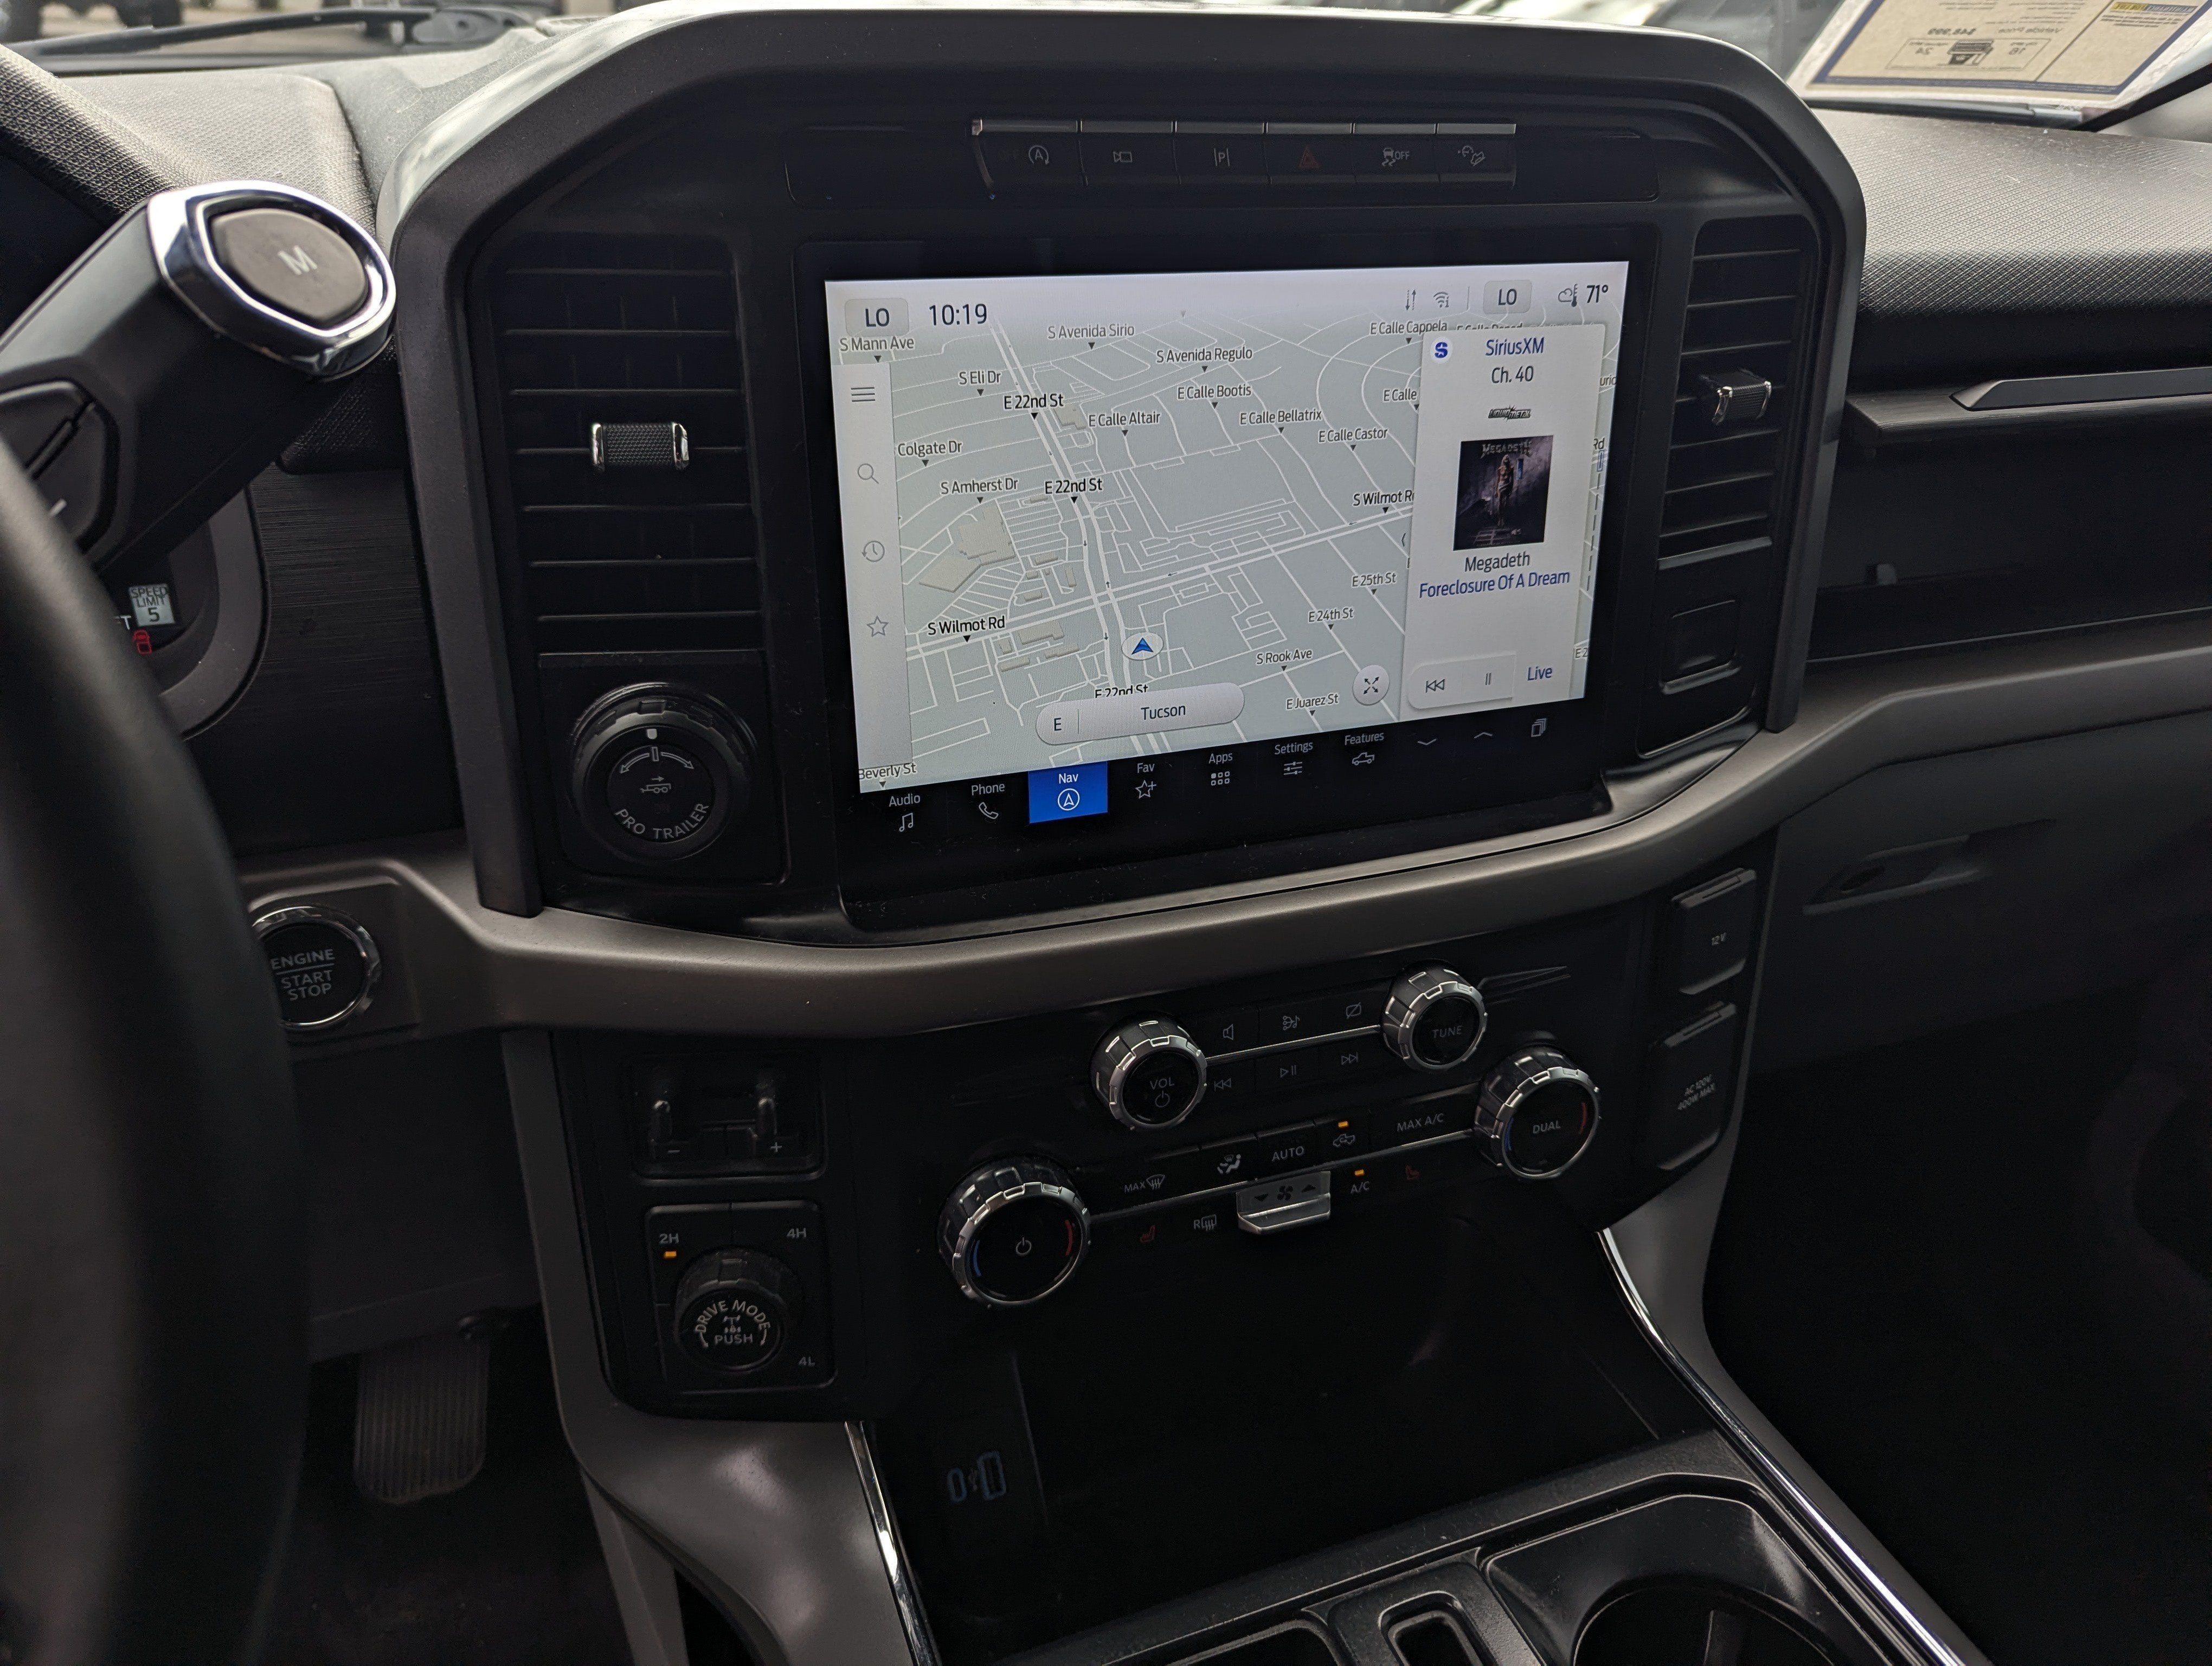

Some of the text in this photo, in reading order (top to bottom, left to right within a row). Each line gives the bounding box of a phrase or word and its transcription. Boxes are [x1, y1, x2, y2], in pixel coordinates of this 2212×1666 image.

[1394, 150, 1410, 161] OFF
[277, 244, 318, 276] M
[1498, 289, 1517, 306] LO
[865, 307, 890, 327] LO
[929, 303, 987, 326] 10:19
[1049, 323, 1134, 339] S Avenida Sirio
[1371, 323, 1377, 334] E
[1379, 322, 1404, 334] Calle
[840, 336, 914, 351] S Mann Ave
[1485, 337, 1545, 356] SiriusXM
[1156, 347, 1252, 363] S Avenida Regulo
[959, 370, 1001, 385] S Eli Dr
[1491, 366, 1534, 384] Ch. 40
[1178, 385, 1251, 399] E Calle Bootis
[1384, 388, 1417, 401] E Calle
[1004, 393, 1064, 409] E 22nd St
[1089, 412, 1161, 427] E Calle Altair
[1240, 408, 1322, 425] E Calle Bellatrix
[1319, 427, 1388, 443] E Calle Castor
[898, 440, 962, 458] Colgate Dr
[941, 478, 1018, 495] S Amherst Dr
[1045, 478, 1103, 494] E 22nd St
[1353, 494, 1360, 506] S
[1363, 491, 1402, 505] Wilmot
[1464, 551, 1530, 573] Megadeth
[1352, 572, 1396, 587] E 25th St
[1419, 572, 1570, 598] Foreclosure Of A Dream
[131, 586, 168, 597] SPEED
[136, 596, 166, 607] LIMIT
[147, 607, 160, 622] 5
[1309, 607, 1353, 623] E 24th St
[928, 616, 1005, 636] S Wilmot Rd
[1257, 649, 1312, 664] S Rook Ave
[1527, 667, 1553, 681] Live
[1287, 694, 1339, 709] E Juarez St
[1053, 703, 1186, 732] E Tucson
[1345, 731, 1384, 746] Features
[1274, 740, 1314, 756] Settings
[1208, 751, 1233, 765] Apps
[859, 762, 916, 779] Beverly St
[1137, 761, 1155, 774] Fav
[1058, 772, 1079, 785] Nav
[971, 781, 1005, 797] Phone
[889, 793, 921, 808] Audio
[615, 803, 709, 839] PRO TRAILER
[271, 949, 336, 970] ENGINE
[281, 970, 333, 989] START
[288, 983, 332, 1002] STOP
[1431, 1024, 1463, 1040] TUNE
[1149, 1078, 1175, 1091] VOL
[1397, 1113, 1445, 1132] MAX A/C
[1532, 1120, 1561, 1135] DUAL
[1271, 1145, 1306, 1163] AUTO
[1123, 1180, 1146, 1194] MAX
[1350, 1180, 1371, 1194] A/C
[1194, 1220, 1200, 1229] R
[659, 1233, 680, 1245] 2H
[787, 1228, 807, 1239] 4H
[695, 1299, 771, 1334] DRIVE MODE
[714, 1333, 753, 1345] PUSH
[799, 1356, 815, 1367] 4L
